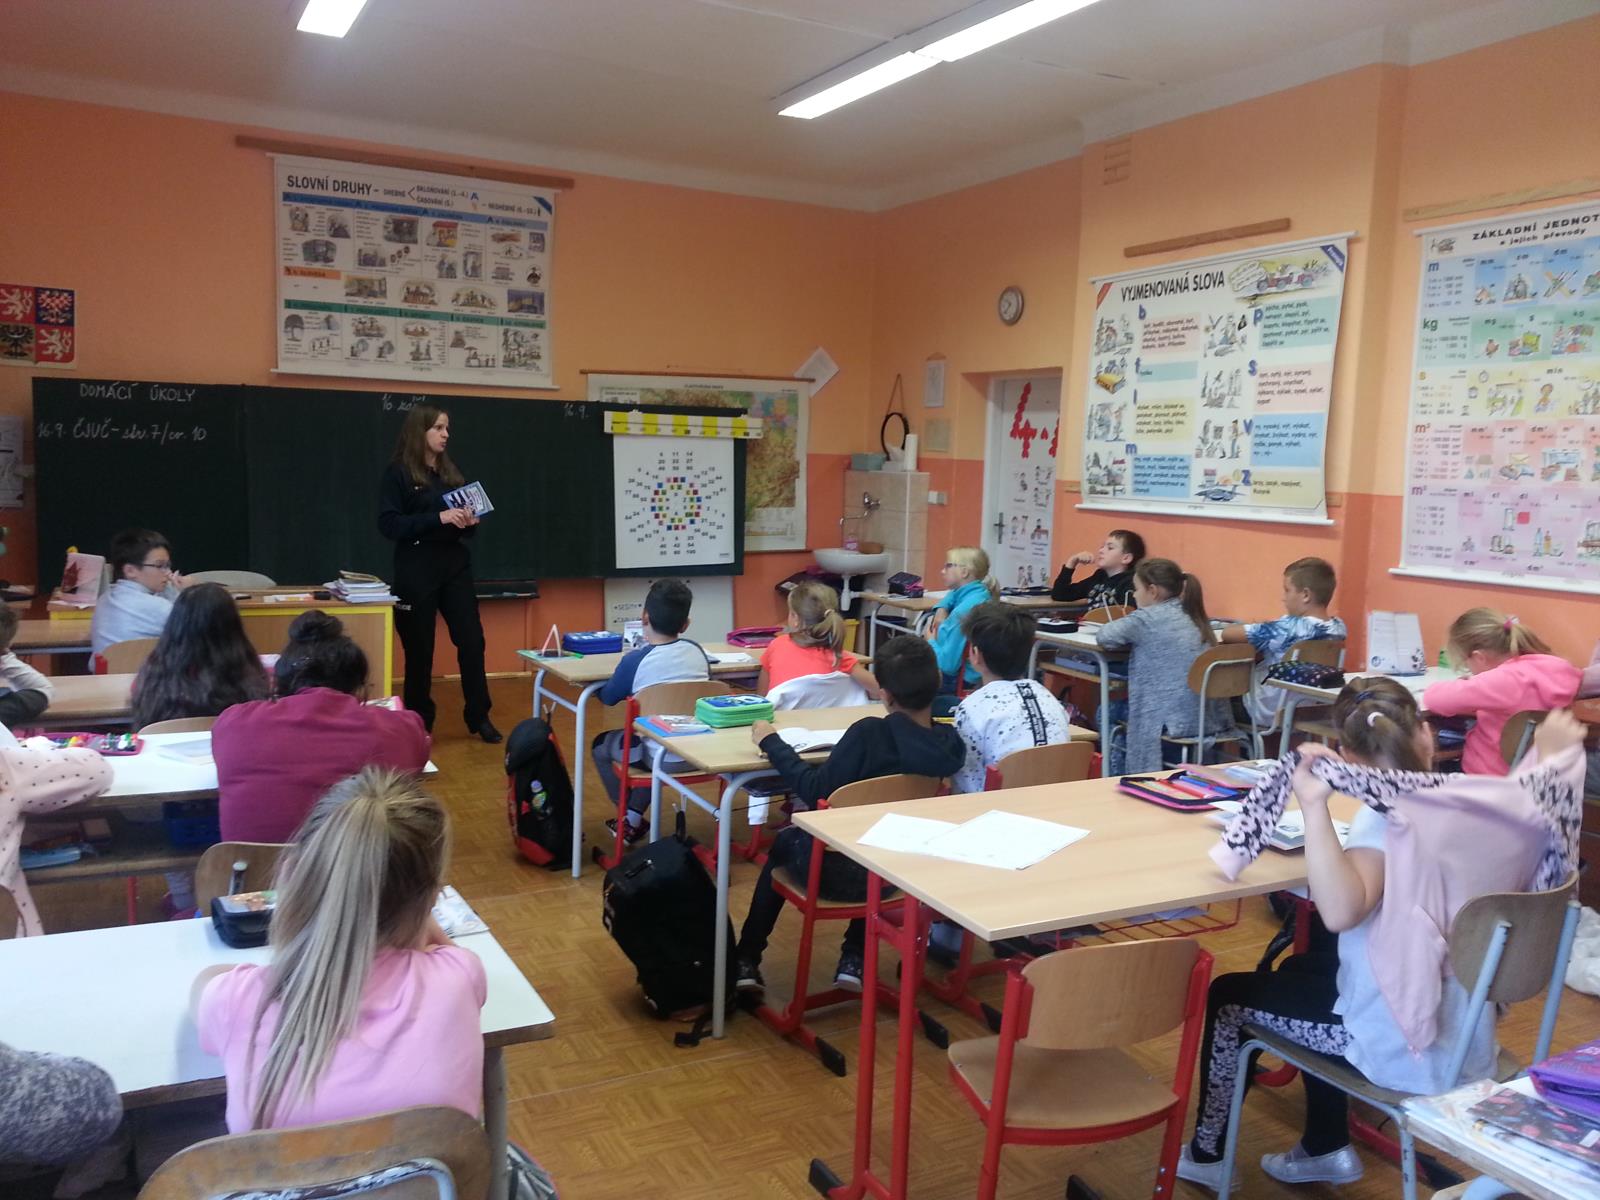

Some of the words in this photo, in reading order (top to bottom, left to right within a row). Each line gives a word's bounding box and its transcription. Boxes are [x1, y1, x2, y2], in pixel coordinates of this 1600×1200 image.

[287, 175, 329, 191] SLOVNÍ
[332, 180, 373, 195] DRUHY
[1472, 222, 1537, 241] ZÁKLADNÍ
[1543, 213, 1600, 230] JEDNOT
[1543, 228, 1587, 241] převody
[1428, 262, 1440, 273] m
[1121, 271, 1190, 302] VYJMENOVANÁ
[1192, 270, 1225, 292] SLOVA
[1253, 309, 1264, 327] p
[1423, 318, 1439, 332] kg
[1248, 359, 1258, 377] s
[80, 382, 138, 400] DOMÁCÍ
[150, 384, 196, 402] ÚKOLY
[1125, 443, 1137, 456] m
